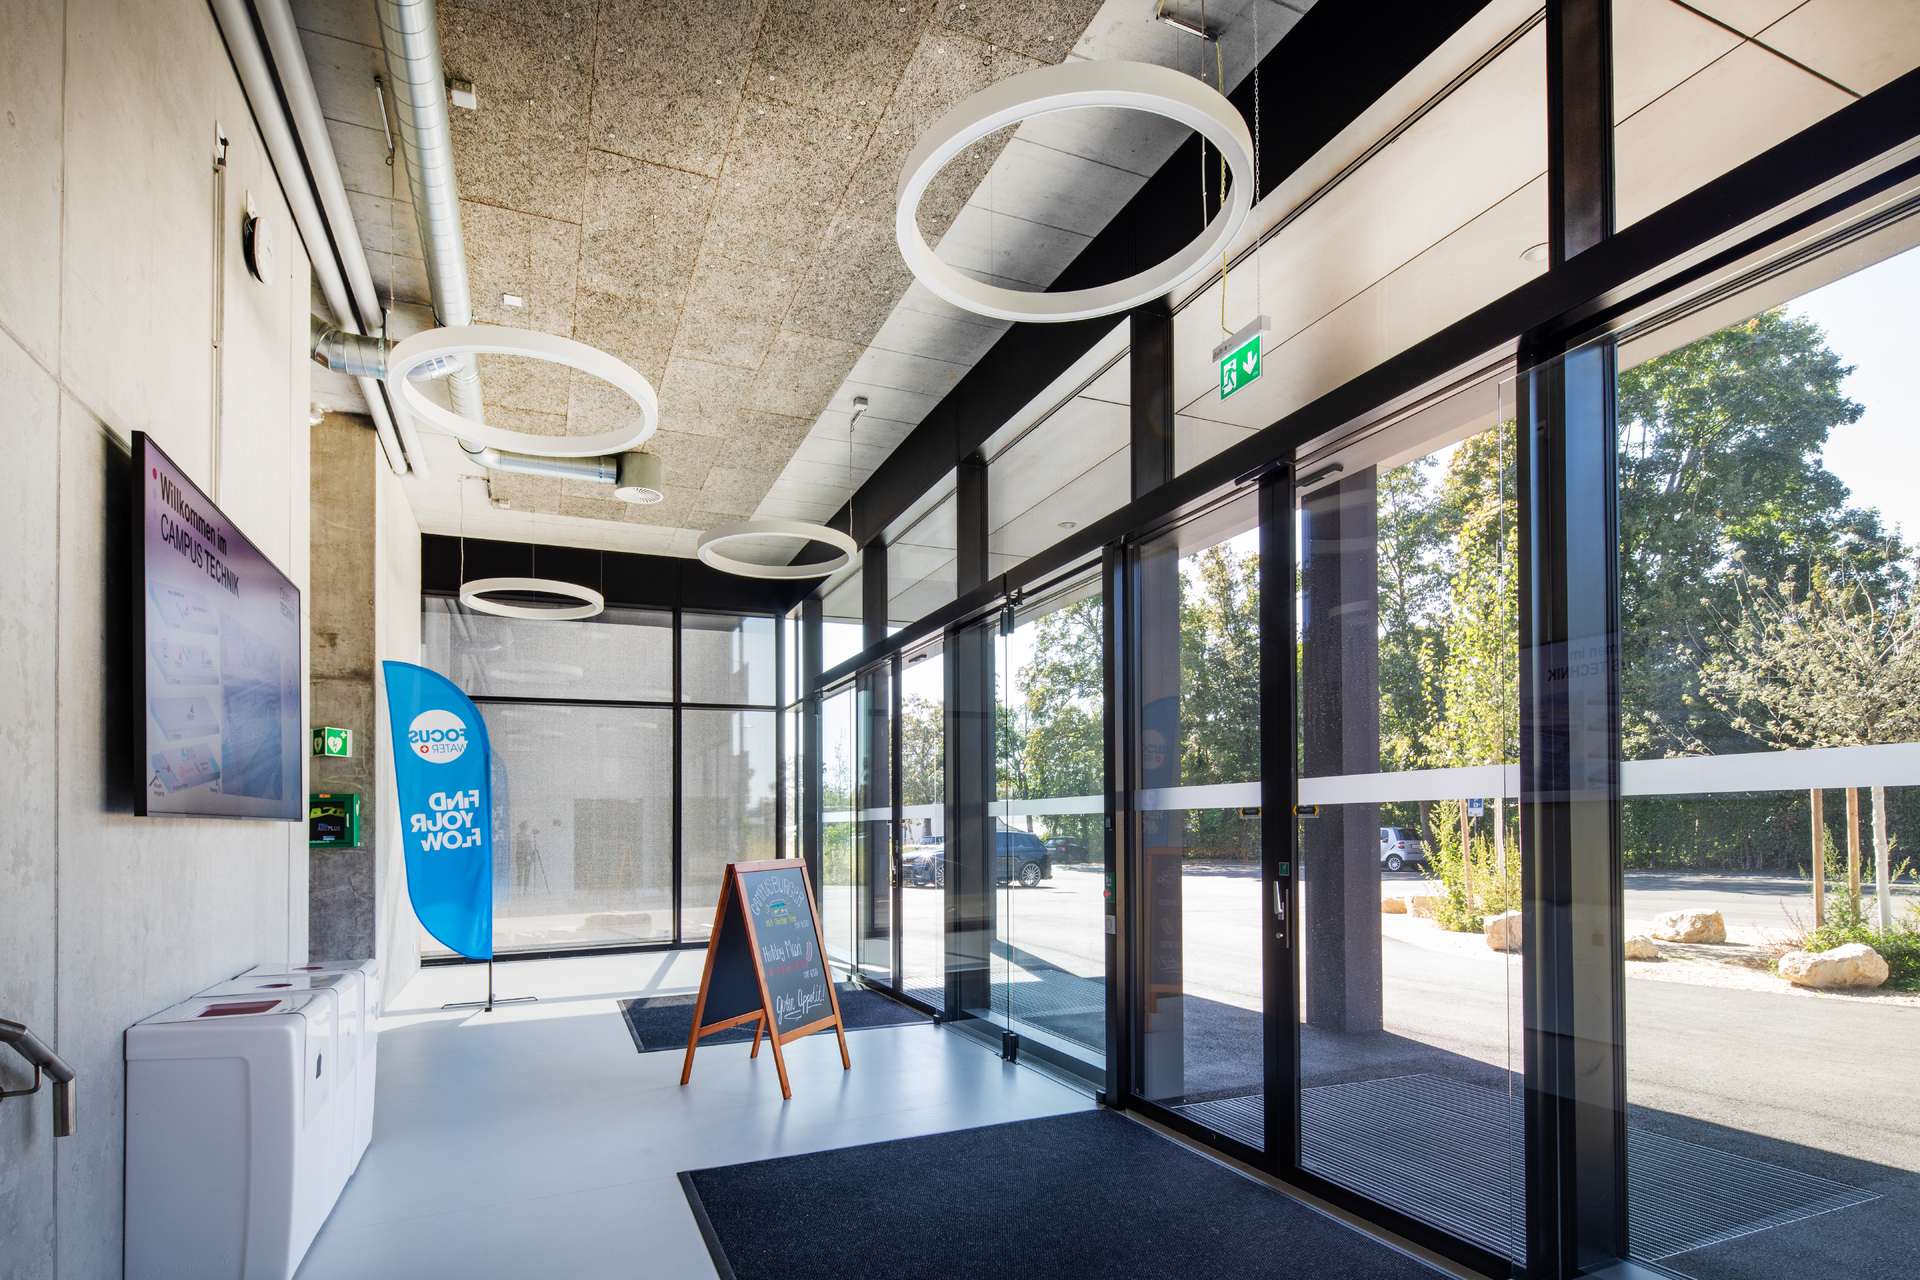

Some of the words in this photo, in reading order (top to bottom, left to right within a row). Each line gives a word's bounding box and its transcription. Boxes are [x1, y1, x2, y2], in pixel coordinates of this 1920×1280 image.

[160, 472, 216, 546] Willkommen
[217, 527, 227, 556] im
[161, 514, 203, 569] CAMPUS
[205, 549, 240, 598] TECHNIK
